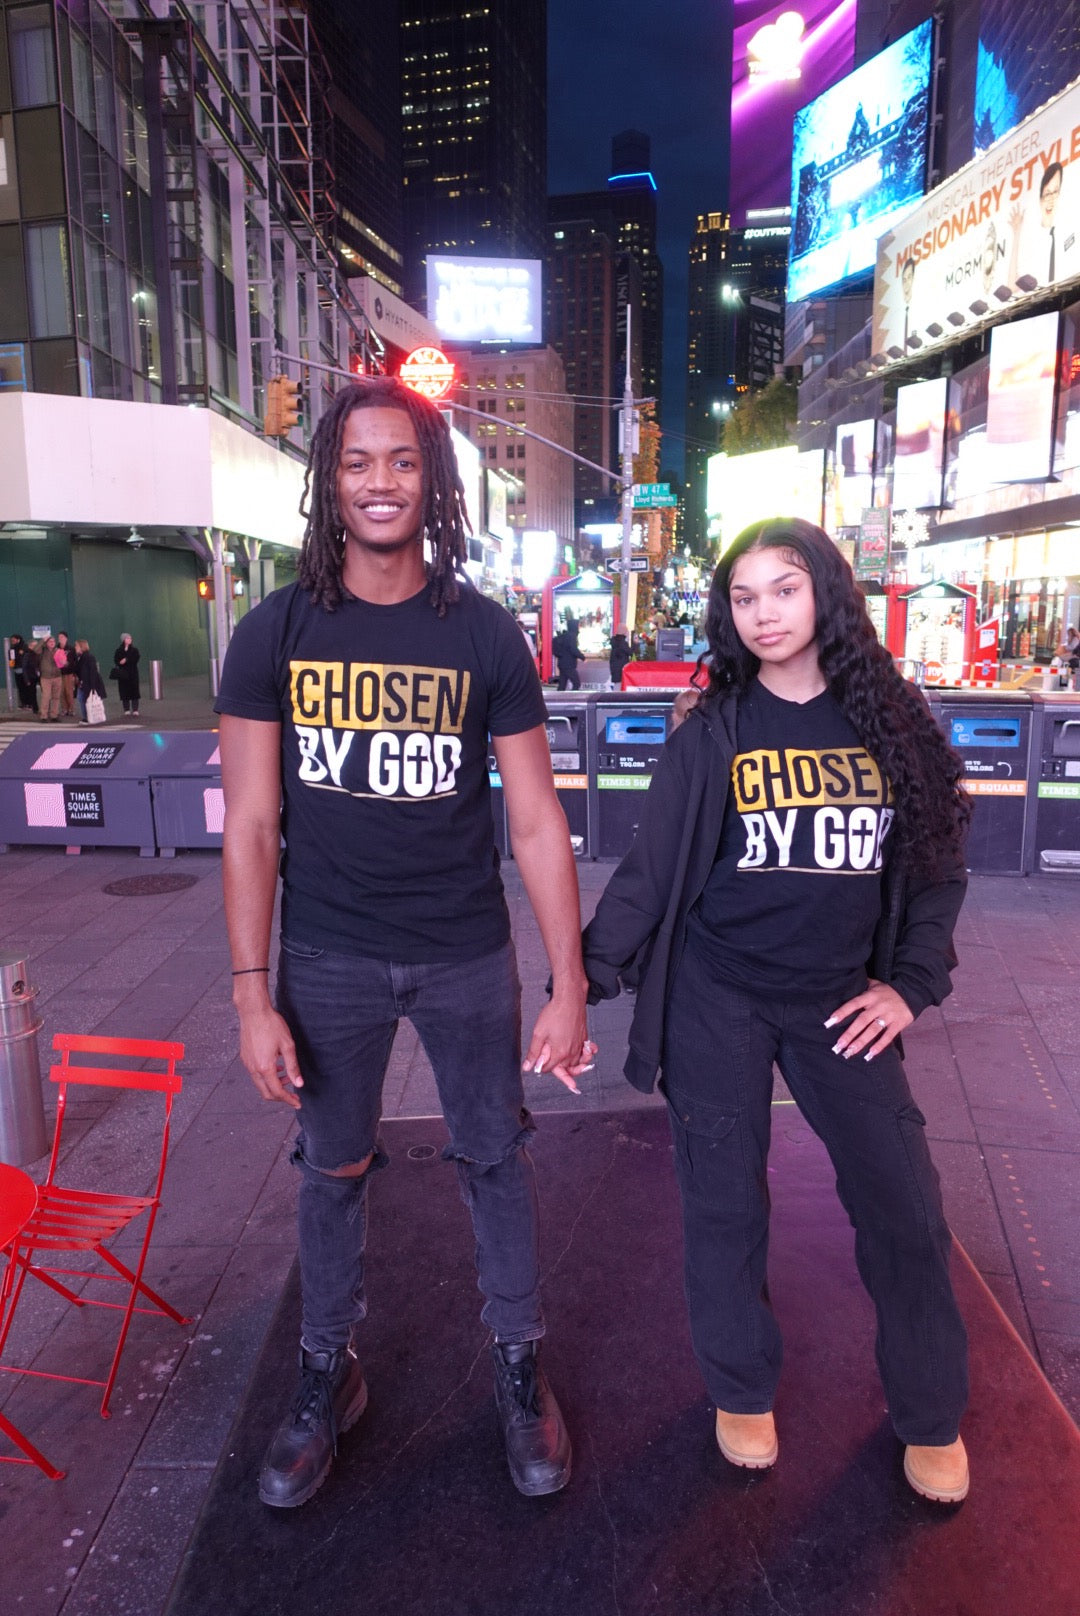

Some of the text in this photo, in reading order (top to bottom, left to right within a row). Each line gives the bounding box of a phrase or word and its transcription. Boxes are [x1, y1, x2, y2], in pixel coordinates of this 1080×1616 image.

[895, 124, 1080, 278] MISSIONARY STYLE
[927, 179, 975, 221] MUSICAL
[945, 238, 1006, 288] MORMN
[385, 308, 408, 338] HYATT
[642, 486, 648, 495] W
[651, 485, 660, 495] 47
[636, 496, 650, 504] Lloyd
[296, 668, 465, 728] CHOSEN
[294, 724, 462, 797] BY GOD
[600, 778, 631, 787] TIMES
[978, 784, 1024, 793] SQUARE
[1041, 786, 1079, 796] TIMES
[70, 792, 97, 802] TIMES
[67, 803, 100, 812] SQUARE
[70, 812, 99, 820] ALLIANCE
[736, 808, 799, 869] BY
